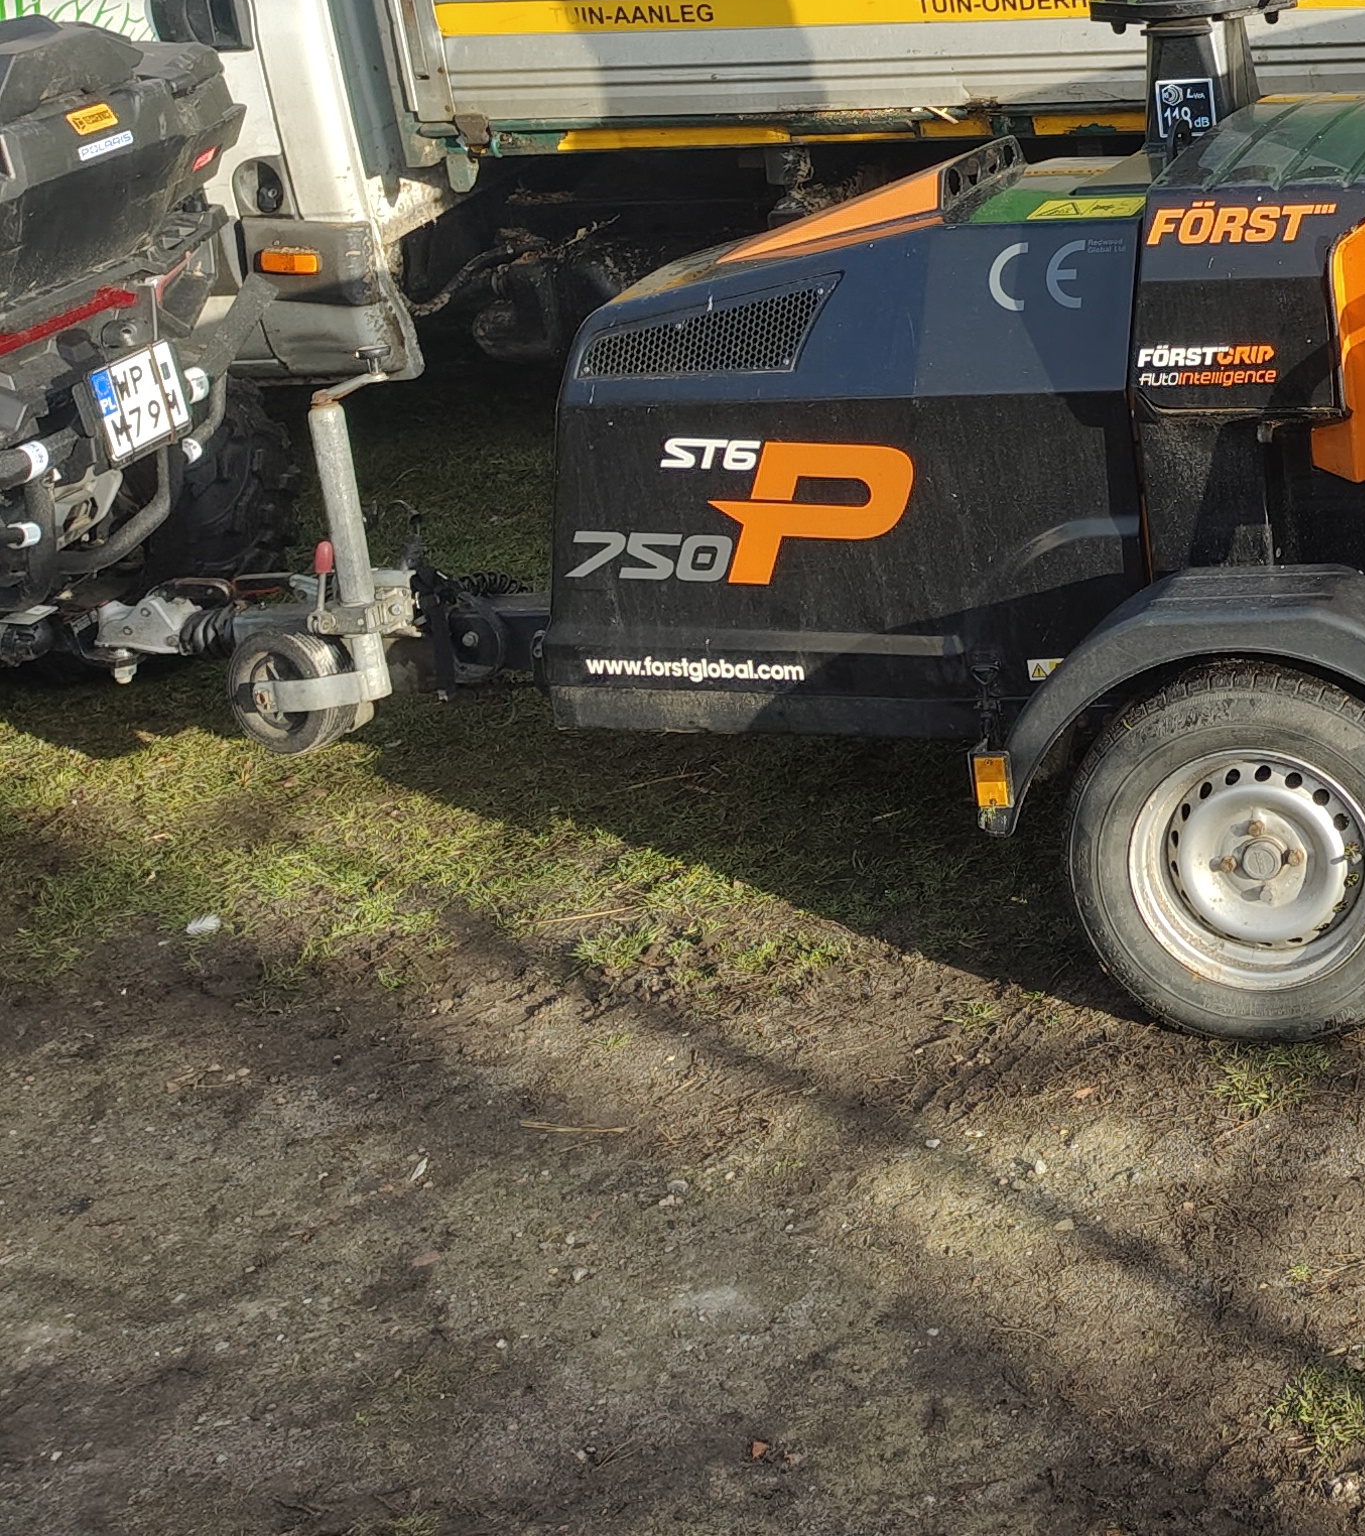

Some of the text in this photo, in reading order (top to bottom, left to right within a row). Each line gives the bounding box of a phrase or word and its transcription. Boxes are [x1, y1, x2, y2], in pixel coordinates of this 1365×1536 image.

[1147, 201, 1336, 246] FÖRST
[564, 531, 734, 582] 750
[586, 657, 805, 682] www.forstglobal.com
